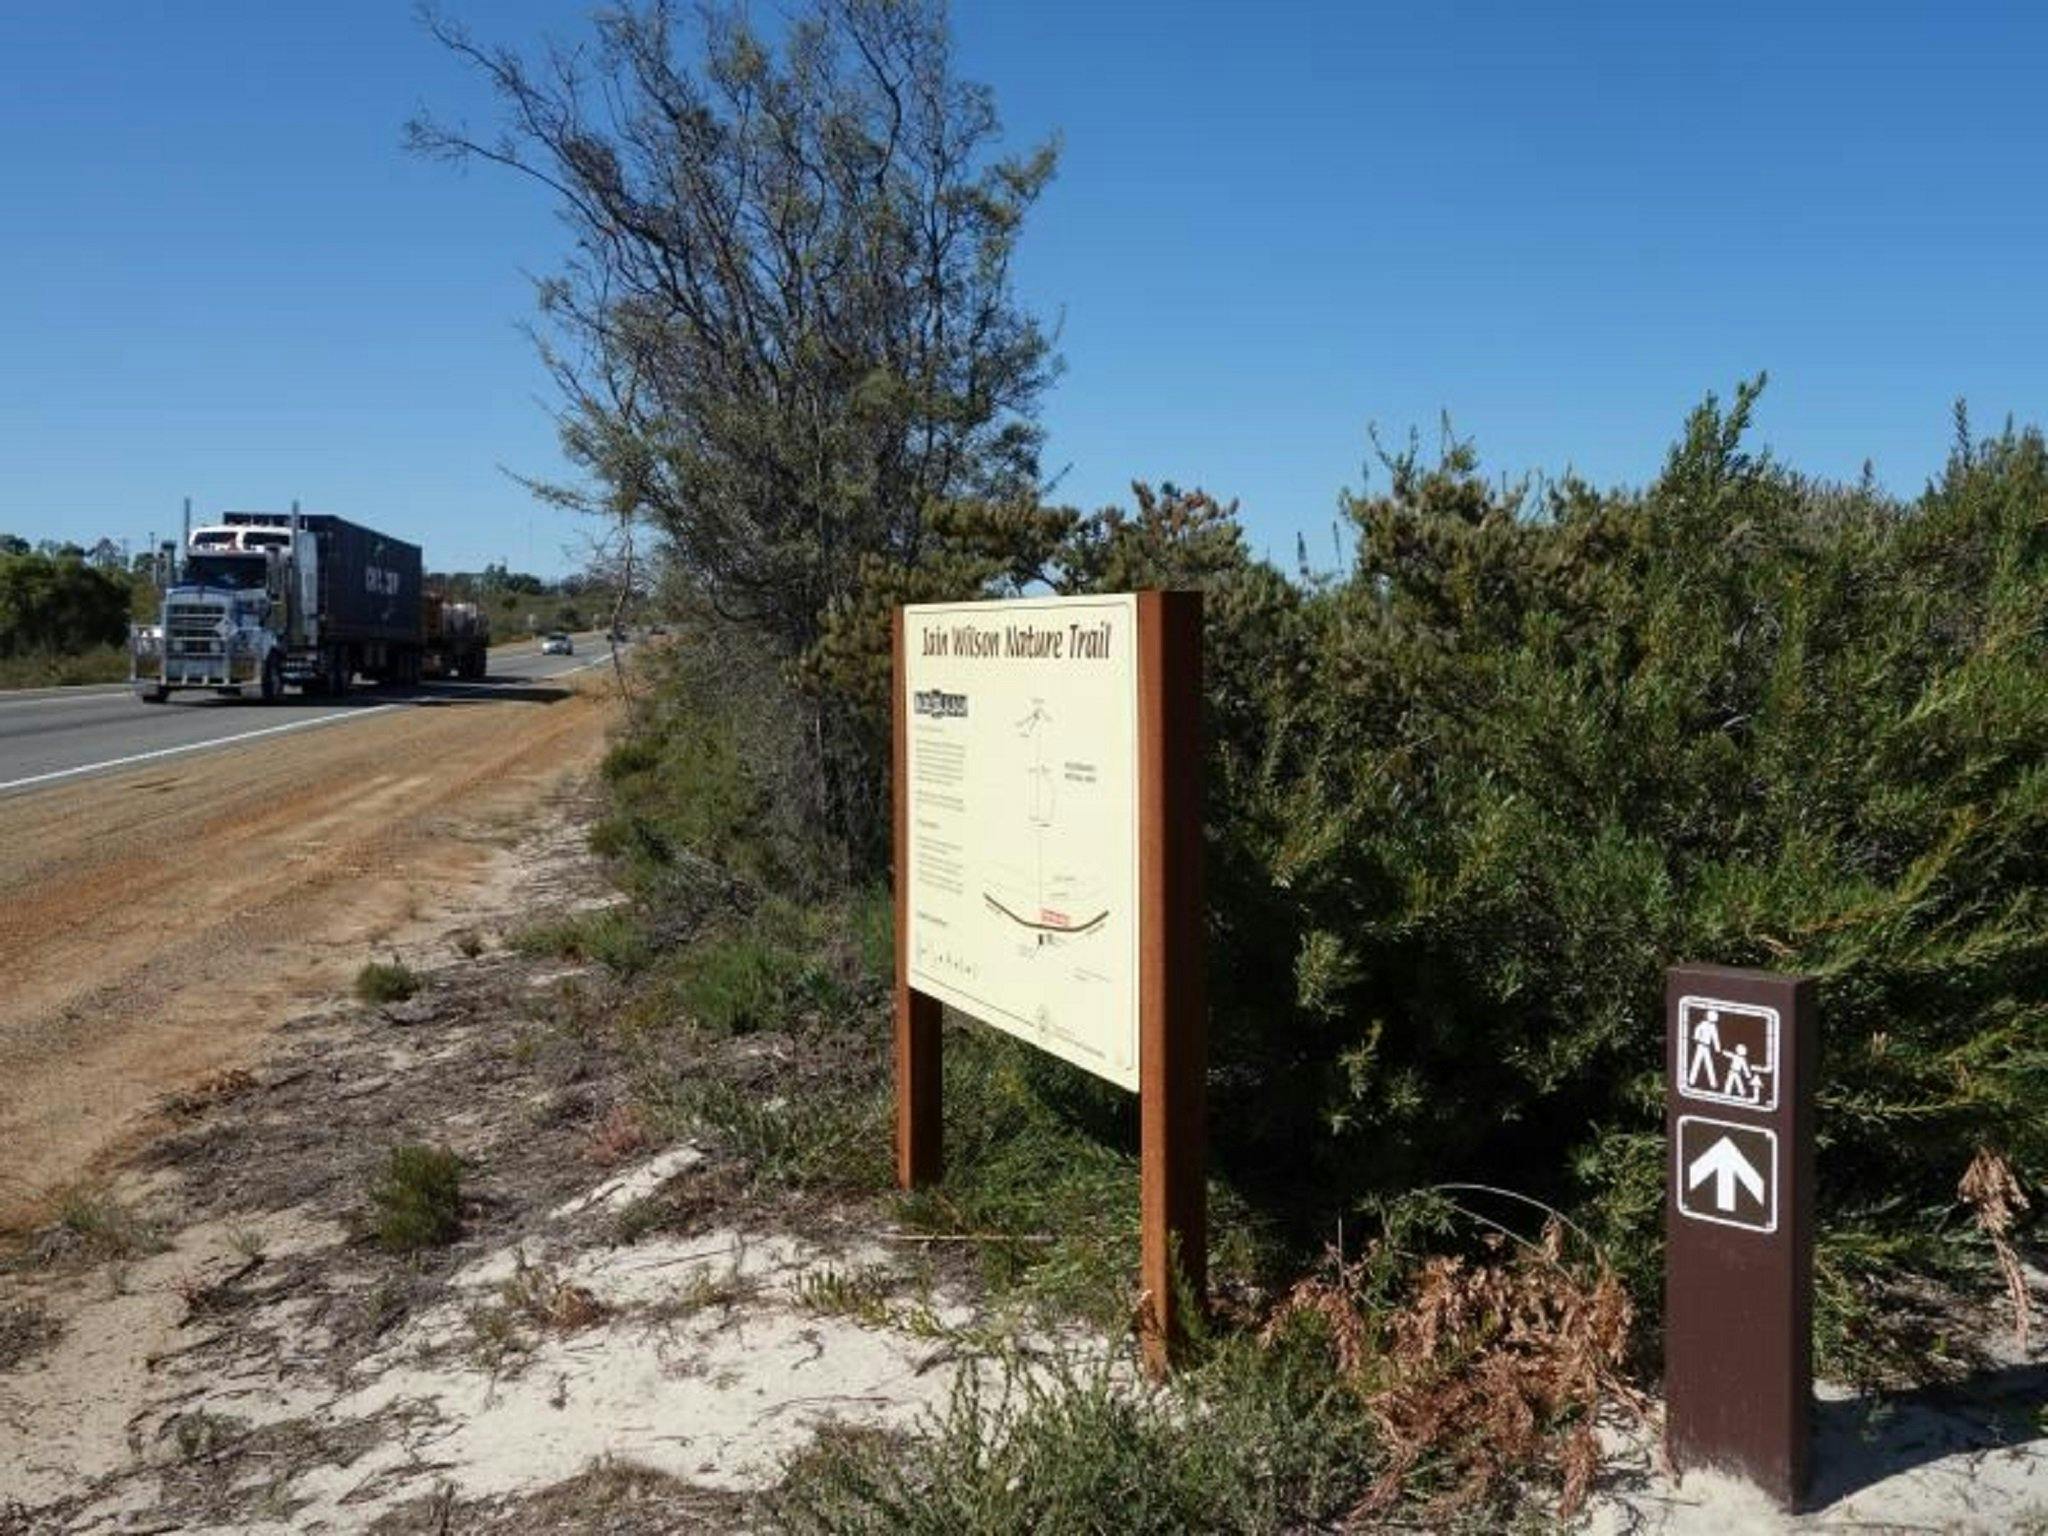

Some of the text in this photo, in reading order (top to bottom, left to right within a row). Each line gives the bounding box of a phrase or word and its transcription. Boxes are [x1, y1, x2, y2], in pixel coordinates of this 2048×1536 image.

[952, 625, 999, 658] Wilson
[1005, 624, 1063, 658] Nature
[1069, 621, 1111, 658] Trail
